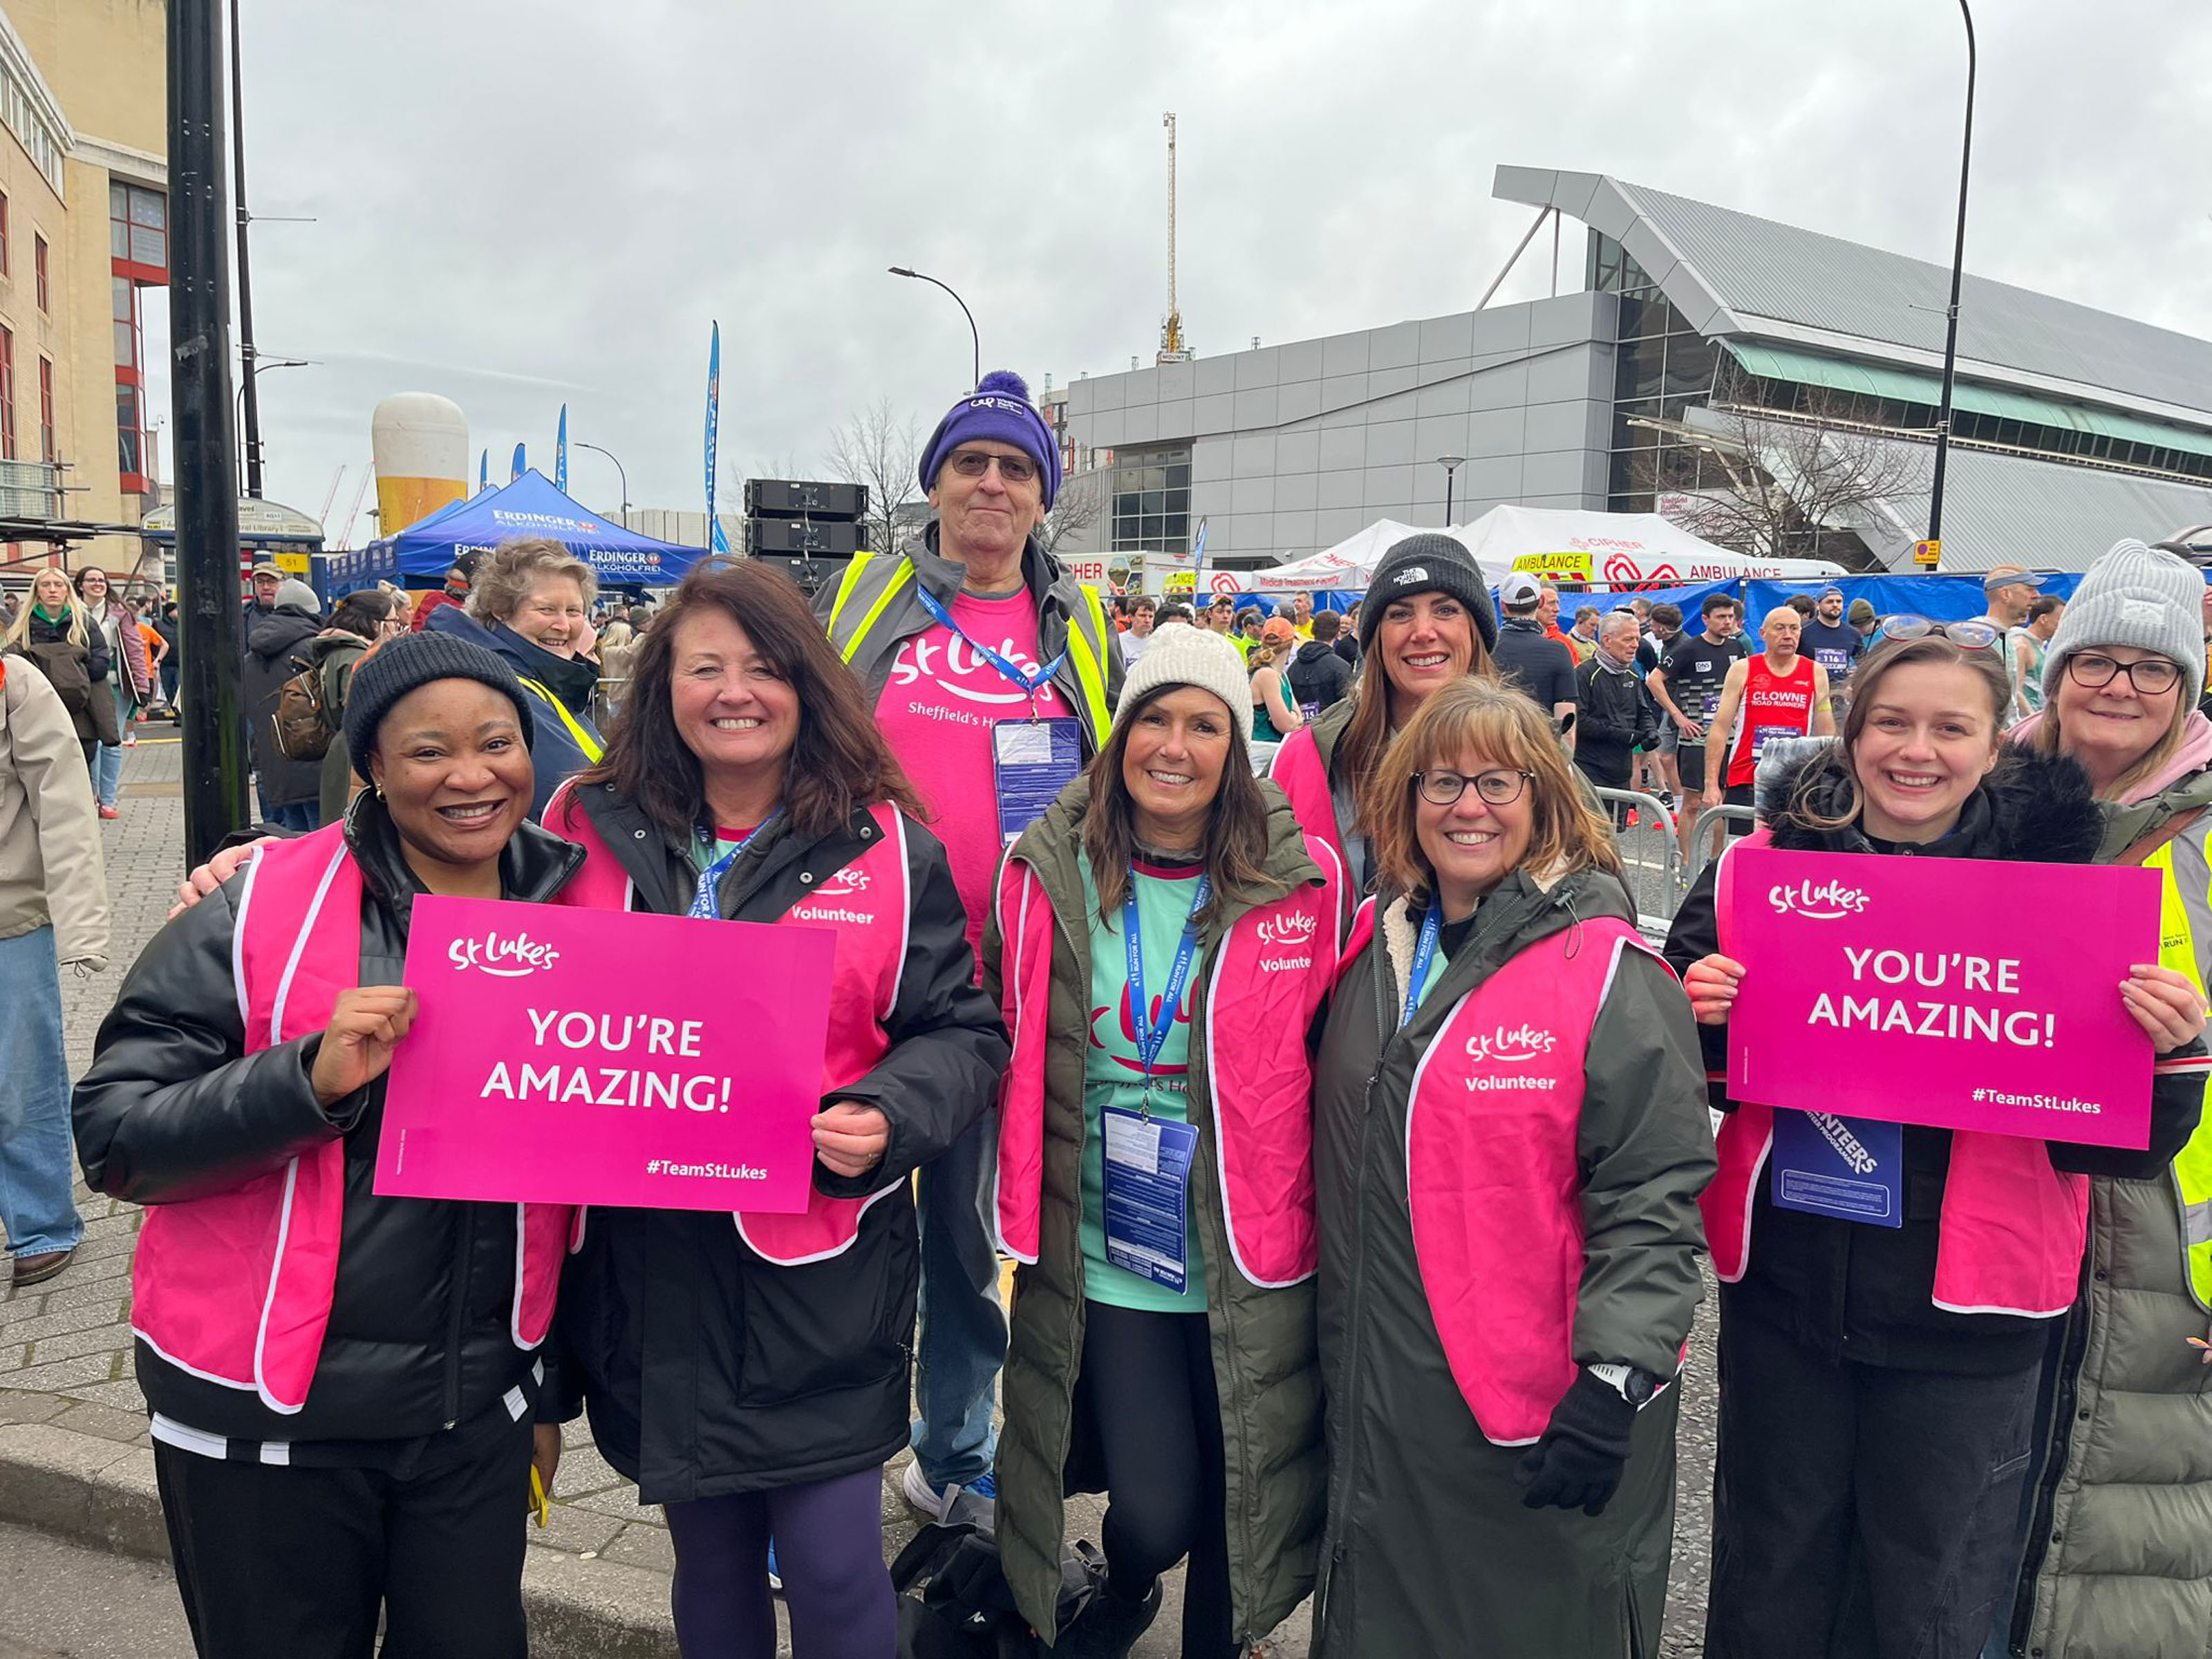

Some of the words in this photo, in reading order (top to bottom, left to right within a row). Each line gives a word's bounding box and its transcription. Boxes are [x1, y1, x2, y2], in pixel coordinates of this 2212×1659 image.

[492, 509, 578, 527] ERDINGER
[1588, 538, 1646, 550] CIPHER
[590, 550, 648, 565] ERDINGER
[1517, 556, 1582, 570] AMBULANCE
[1752, 691, 1808, 704] CLOWNE
[1777, 701, 1806, 709] RUNNERS
[908, 702, 979, 727] Sheffield's
[1801, 879, 1870, 914] Luke's
[792, 905, 874, 924] Volunteer
[486, 932, 560, 969] Luke's
[2164, 938, 2183, 949] RUN
[1808, 993, 2055, 1048] AMAZING!
[1496, 1024, 1556, 1052] Luke's
[480, 1061, 732, 1113] AMAZING!
[1465, 1075, 1555, 1091] Volunteer
[1972, 1088, 2101, 1115] #TeamStLukes
[1815, 1112, 1878, 1174] NTEERS
[1819, 1125, 1856, 1168] PROGRAMME
[646, 1159, 768, 1179] #TeamStLukes
